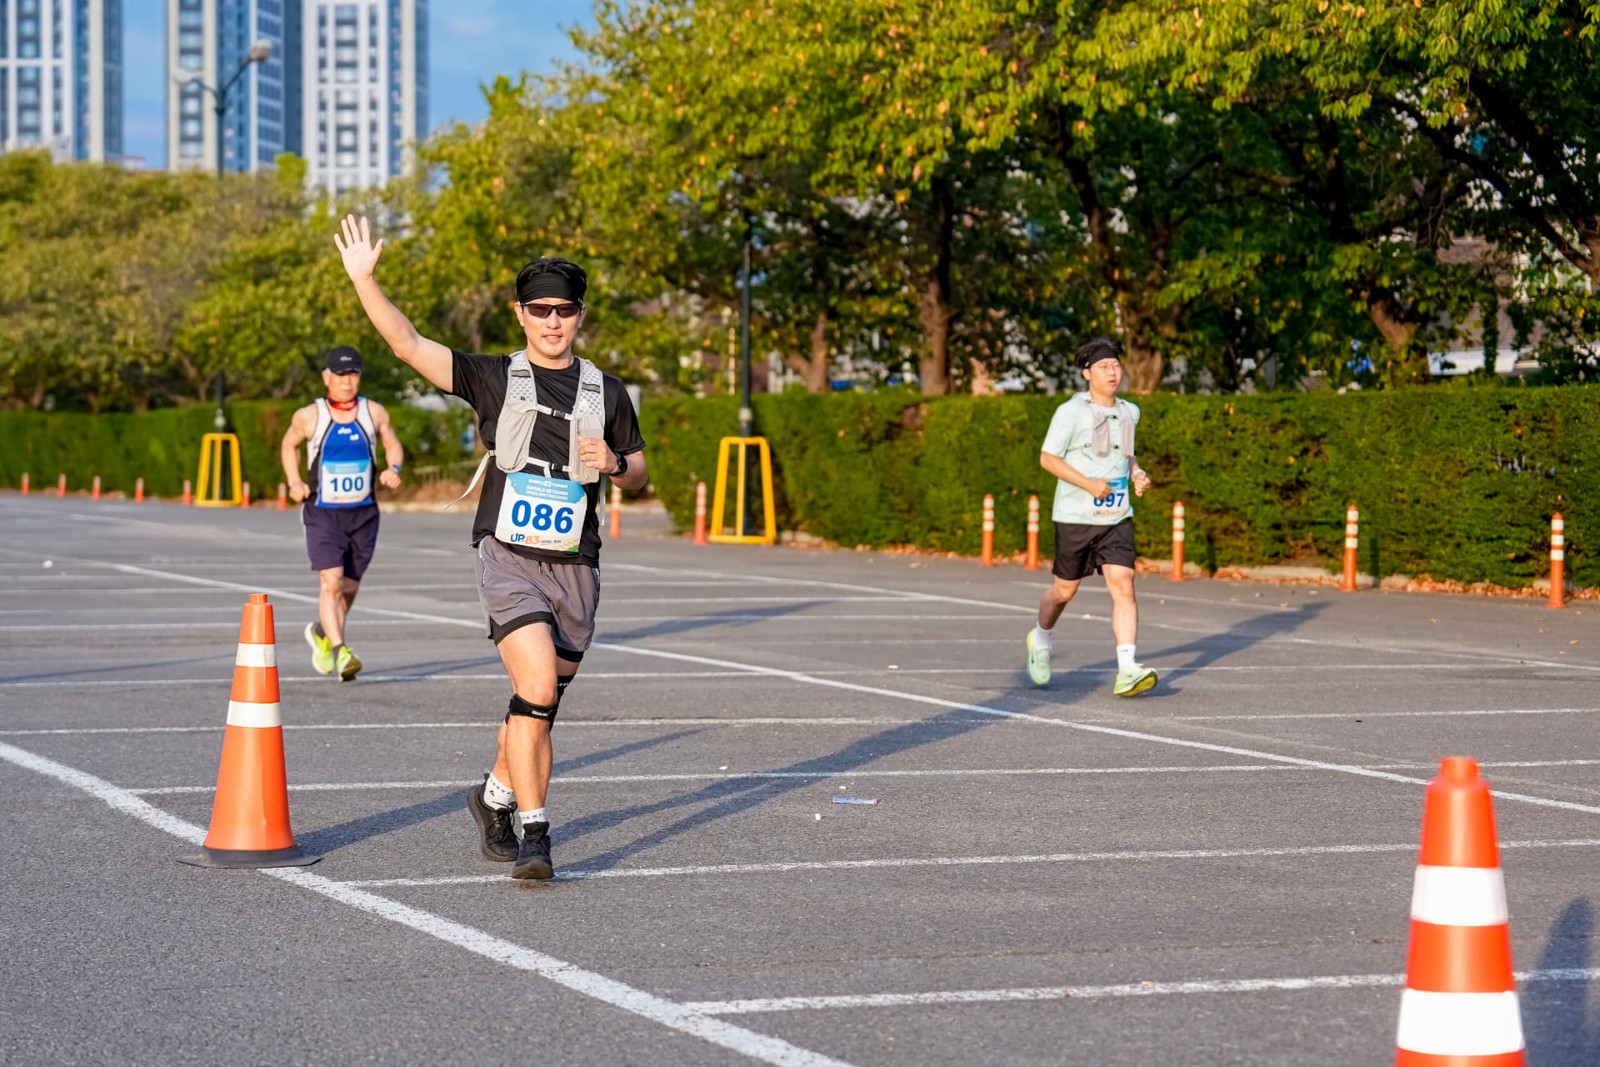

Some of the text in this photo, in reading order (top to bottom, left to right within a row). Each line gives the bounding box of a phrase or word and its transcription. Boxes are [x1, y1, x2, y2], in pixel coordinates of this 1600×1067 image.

[330, 476, 364, 493] 100
[1093, 492, 1125, 508] 097
[511, 499, 574, 534] 086
